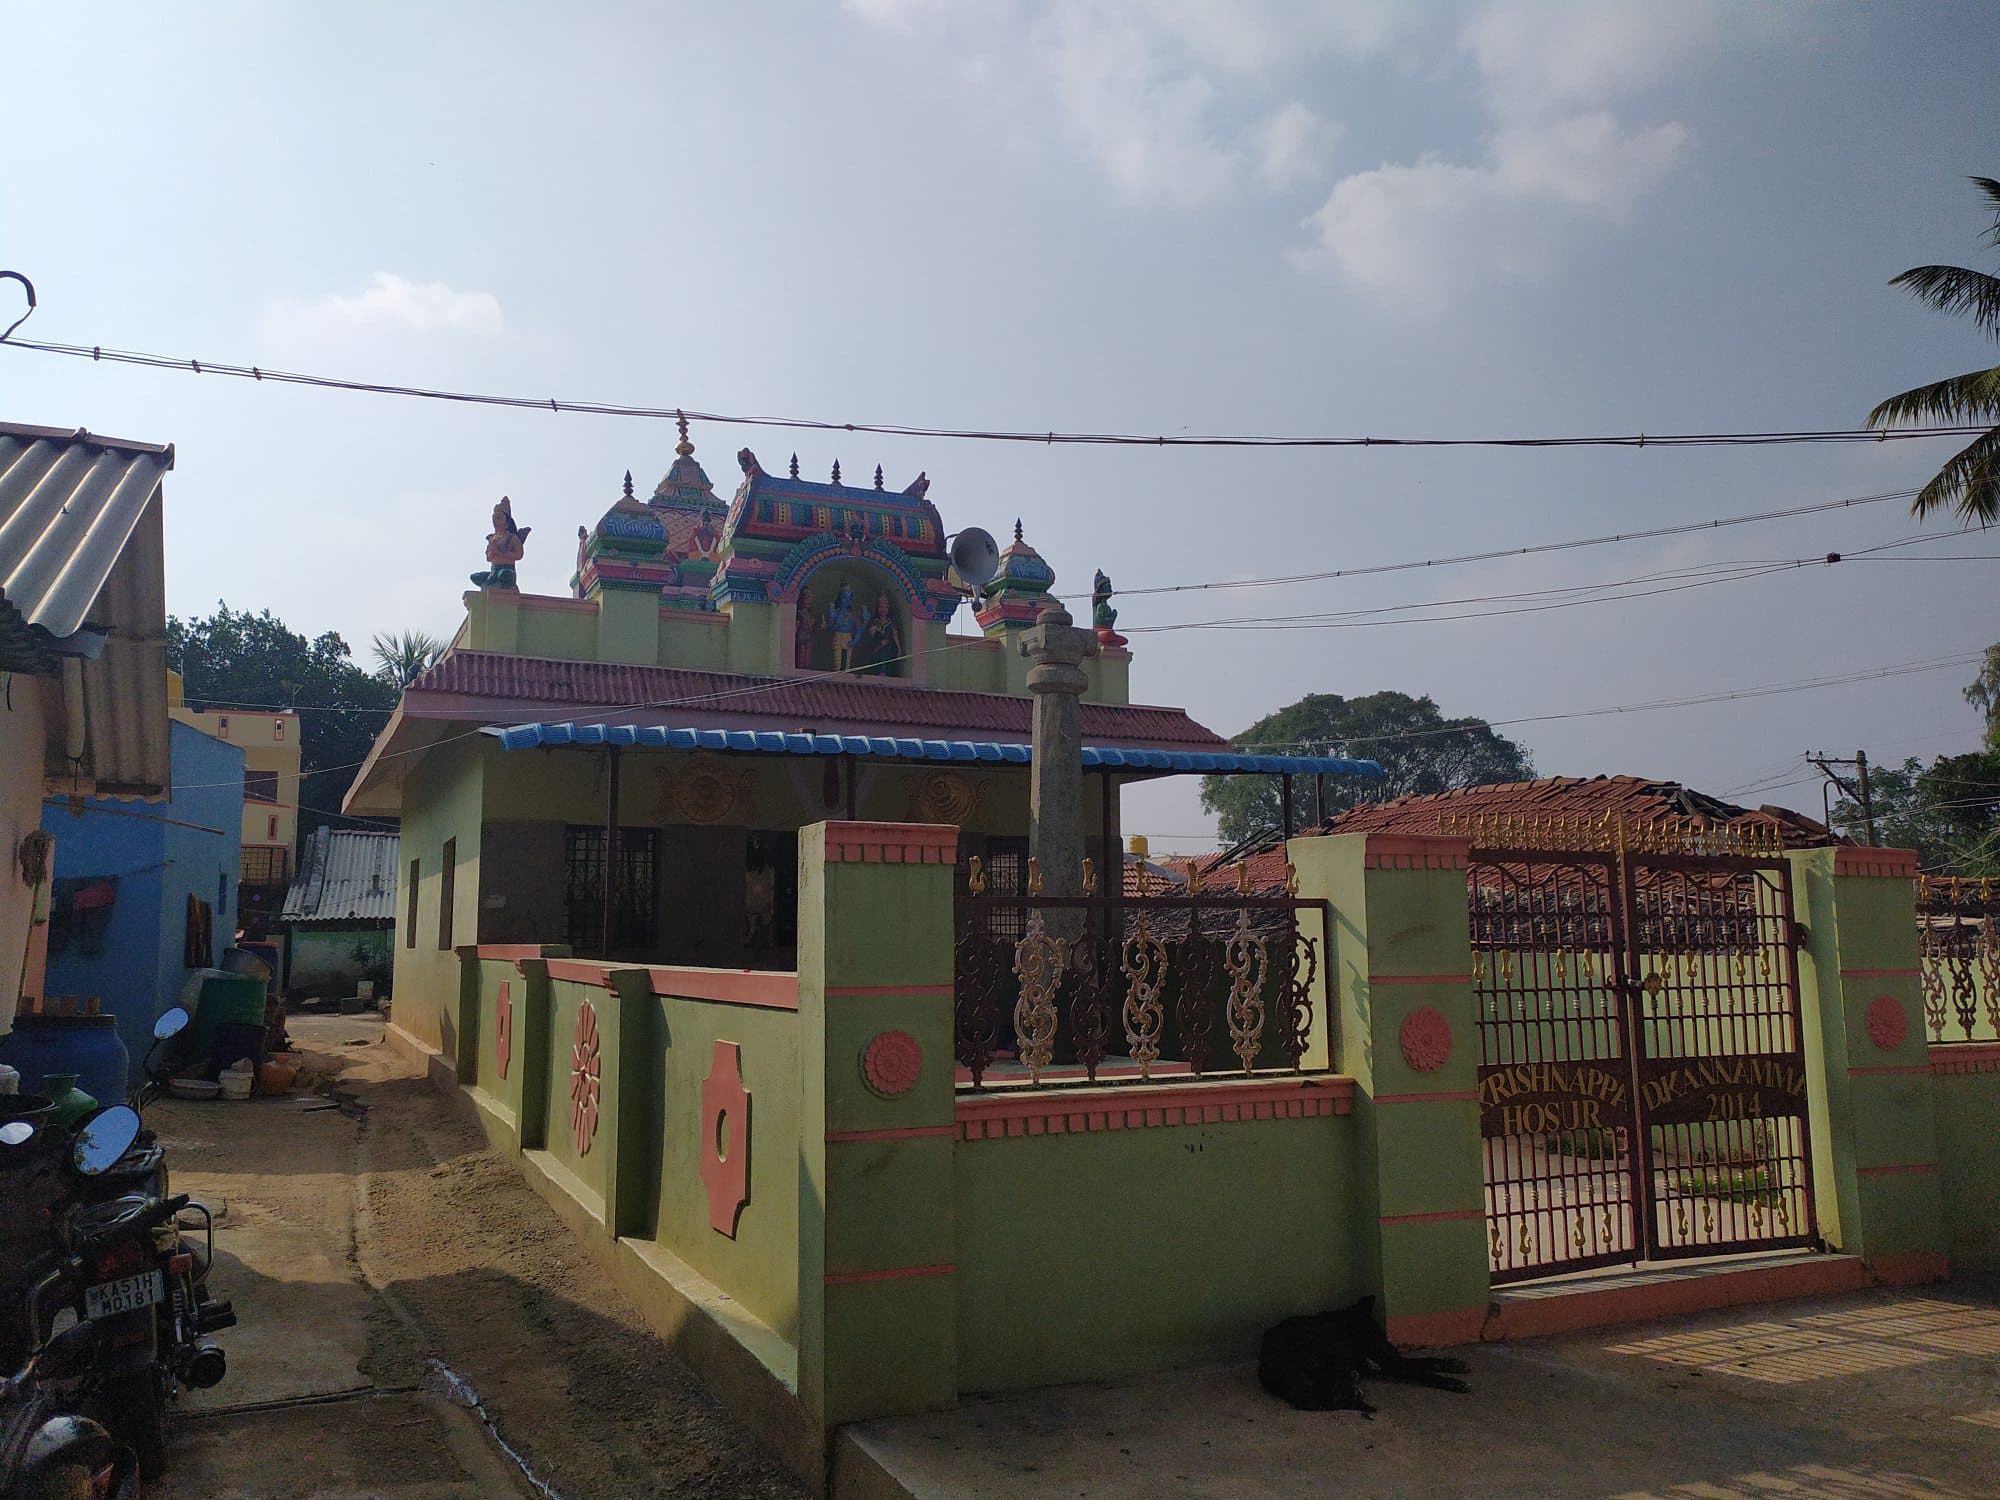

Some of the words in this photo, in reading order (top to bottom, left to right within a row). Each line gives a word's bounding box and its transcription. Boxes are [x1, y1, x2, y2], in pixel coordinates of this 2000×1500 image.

[1502, 1099, 1603, 1136] HOSUR
[1705, 1091, 1761, 1121] 2014
[99, 1273, 152, 1299] KA51H
